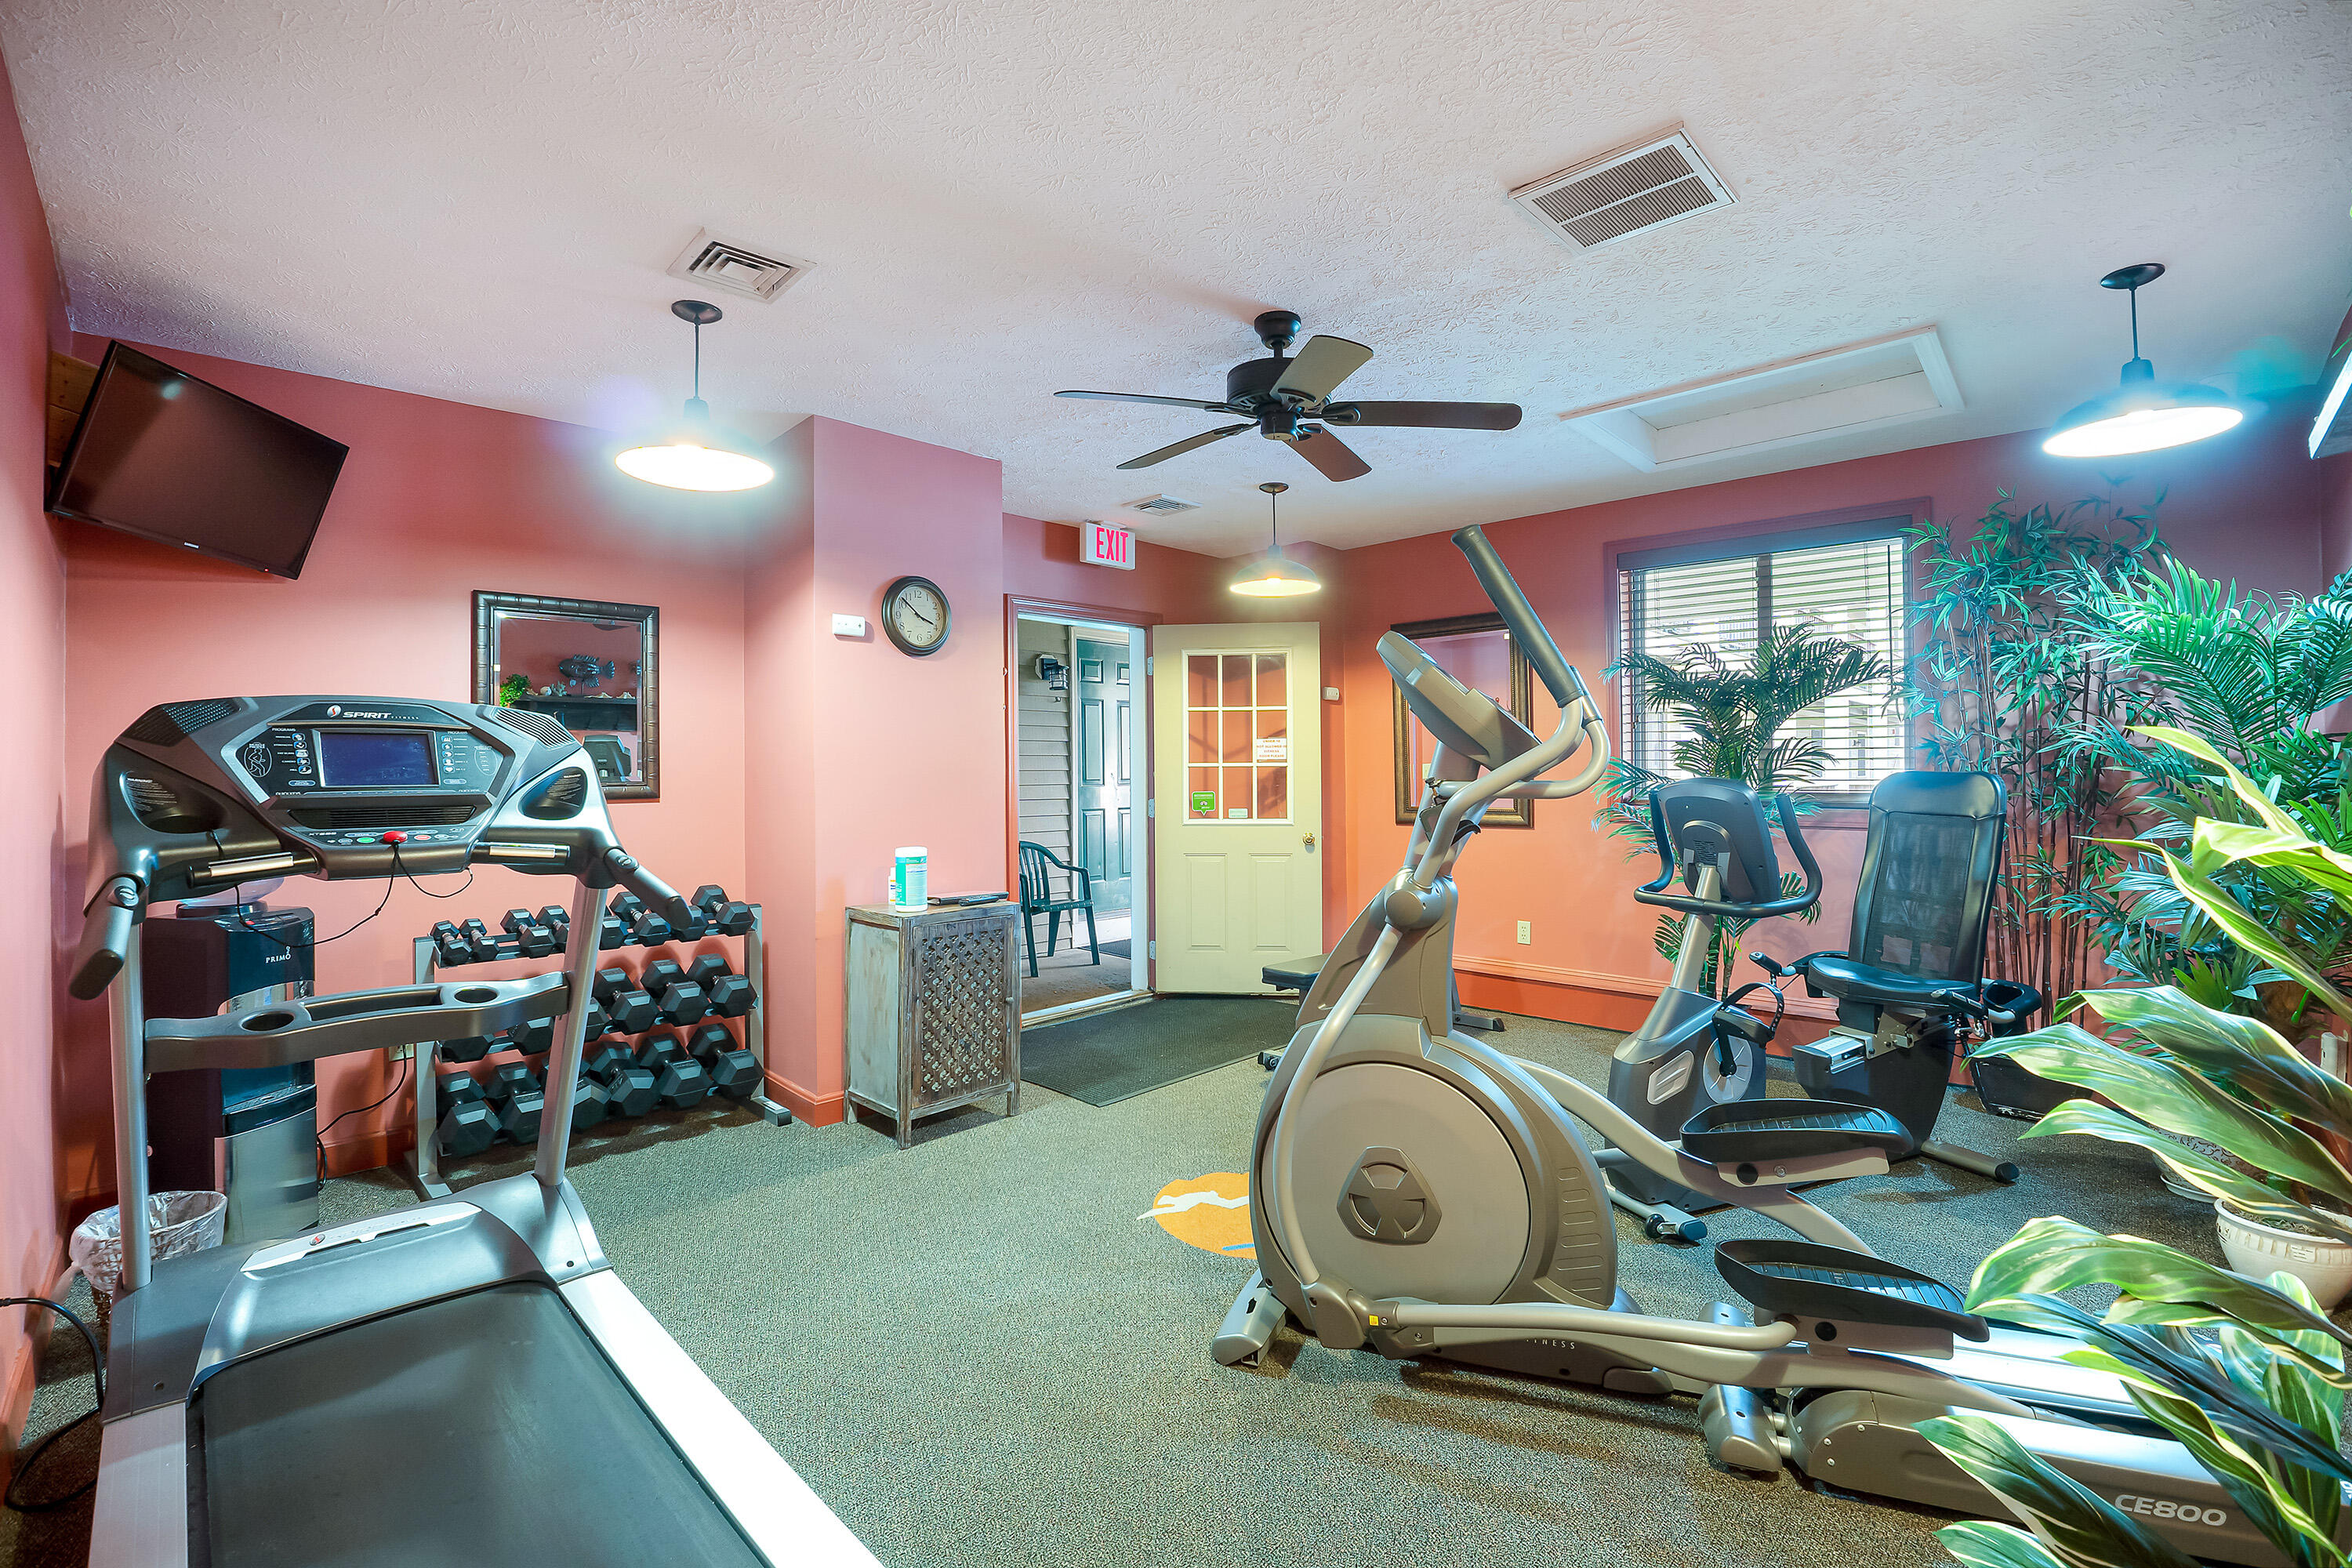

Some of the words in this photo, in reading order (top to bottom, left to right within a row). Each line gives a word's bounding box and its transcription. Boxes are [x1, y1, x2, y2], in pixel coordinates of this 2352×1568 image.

[1096, 527, 1129, 563] EXIT
[932, 601, 938, 610] 2
[895, 611, 902, 619] 9
[935, 612, 941, 621] 3
[899, 622, 905, 630] 8
[916, 633, 923, 642] 6
[266, 954, 291, 964] PRIMO
[2114, 1494, 2227, 1526] CE800
